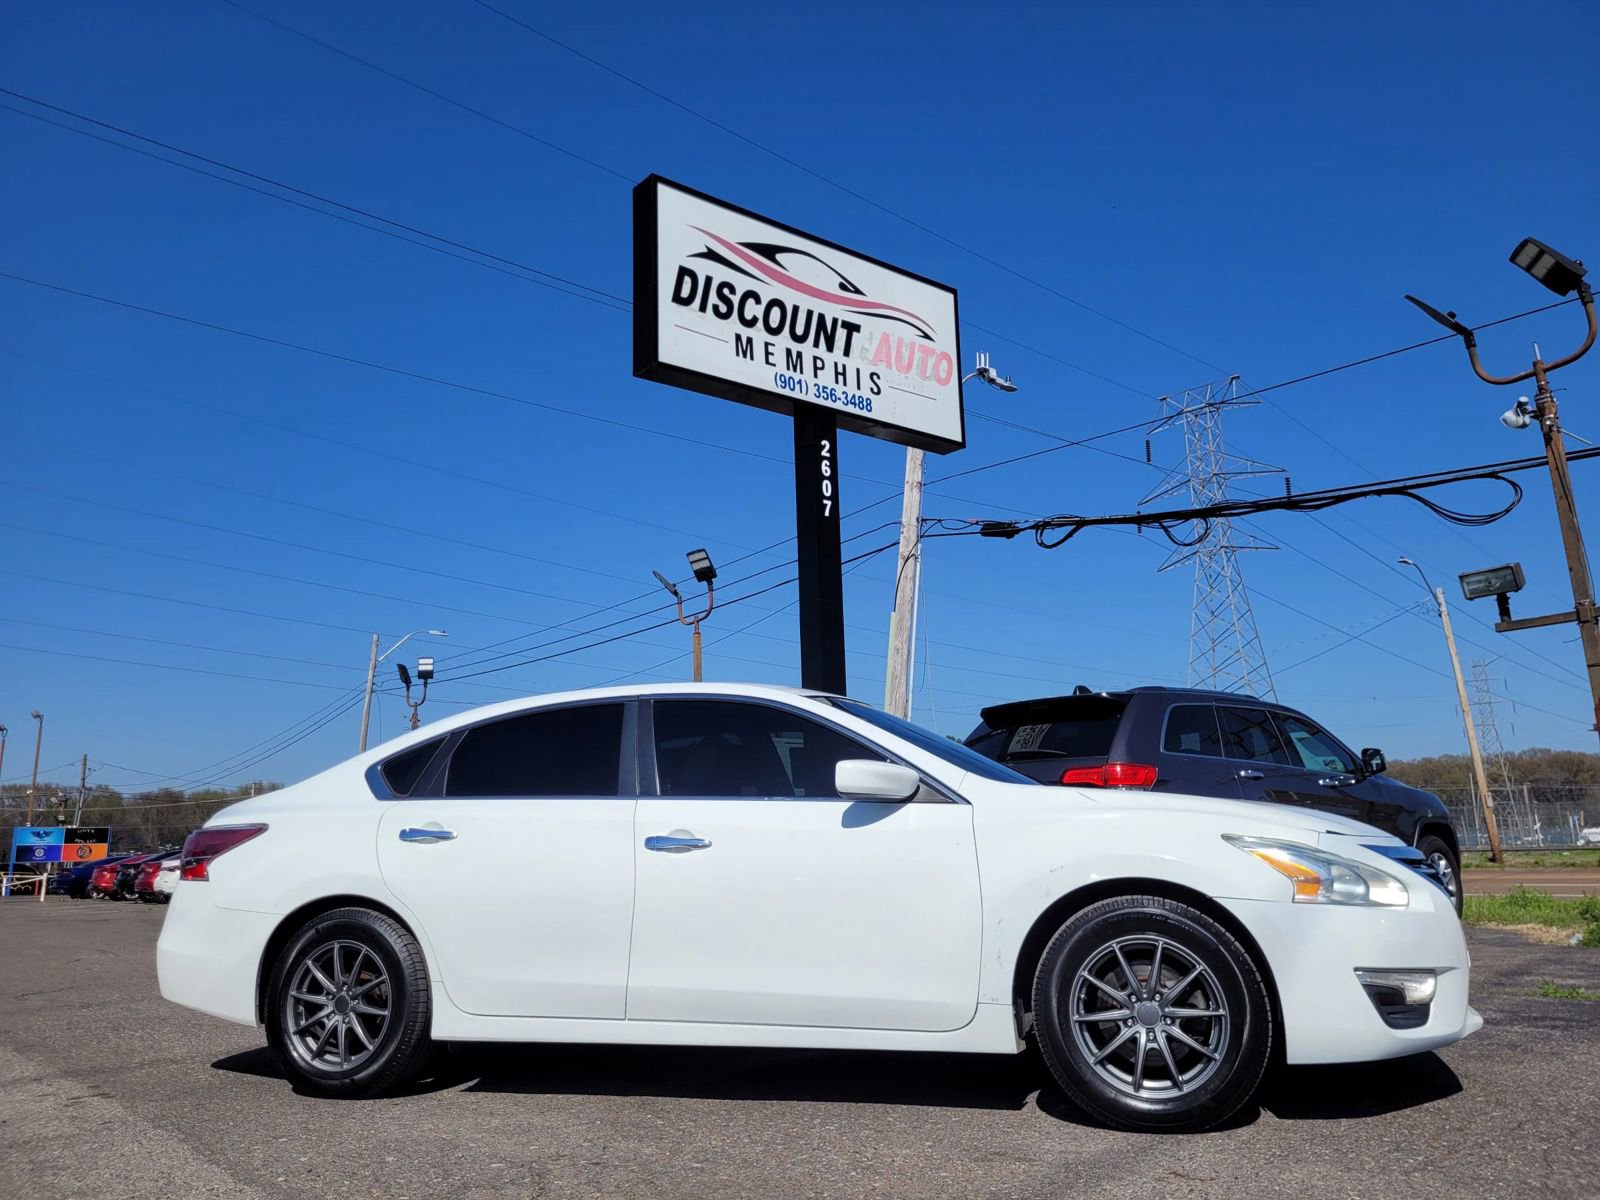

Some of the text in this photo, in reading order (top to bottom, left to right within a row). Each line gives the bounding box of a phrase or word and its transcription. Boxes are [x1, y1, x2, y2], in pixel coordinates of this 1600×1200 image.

[671, 264, 953, 386] DISCOUNT AUTO
[735, 333, 882, 396] MEMPHIS
[774, 372, 873, 413] (901) 356-3488
[820, 440, 832, 517] 2607
